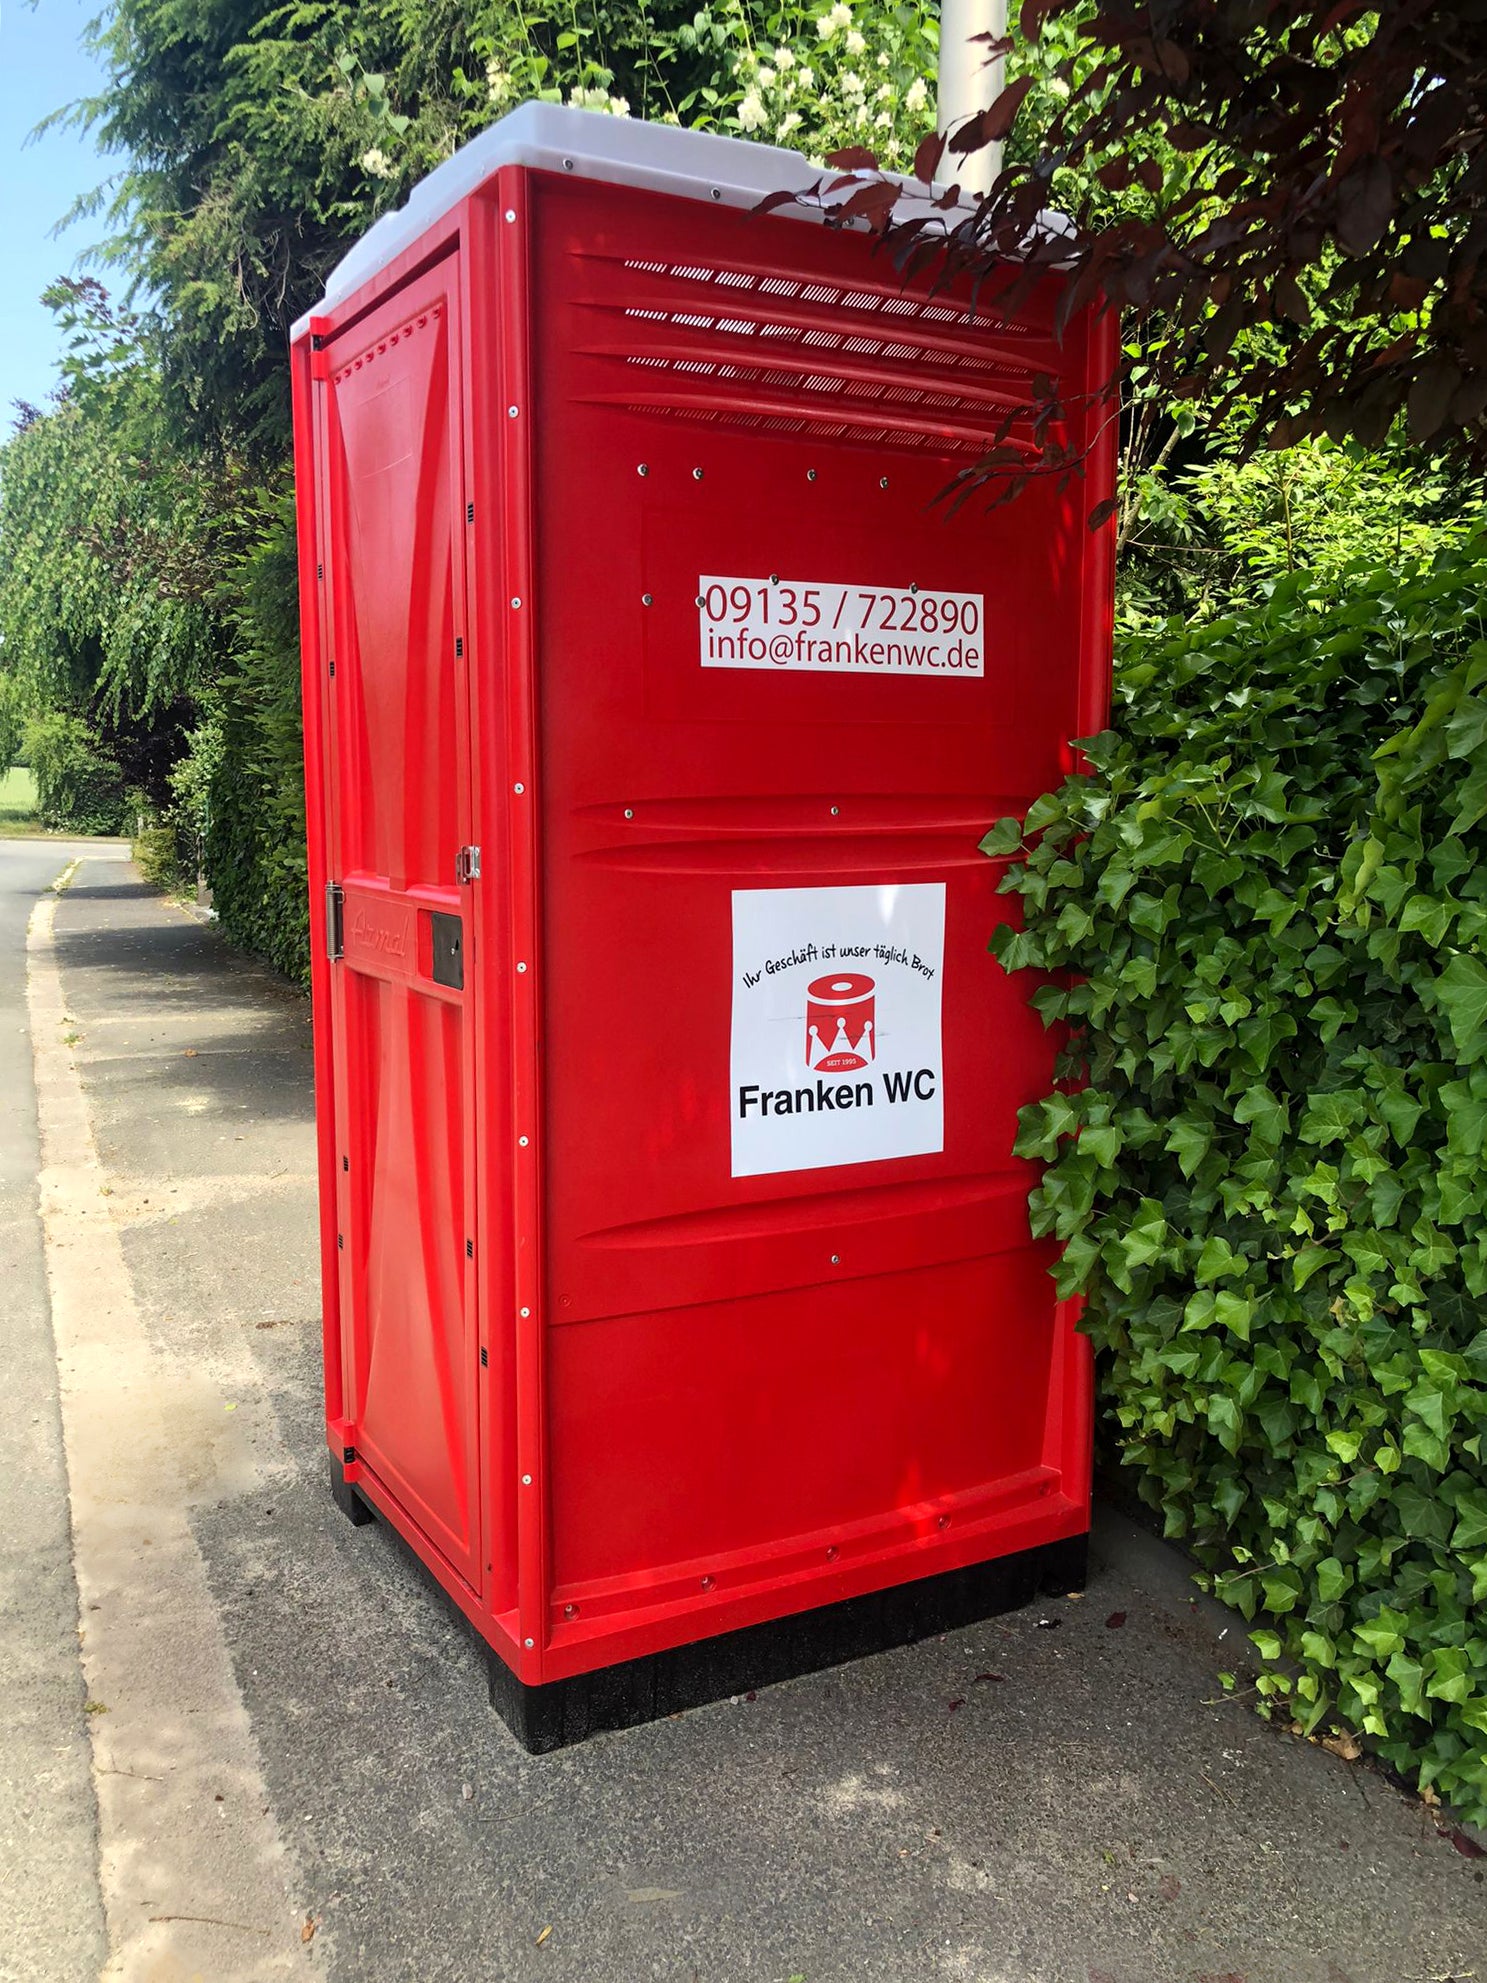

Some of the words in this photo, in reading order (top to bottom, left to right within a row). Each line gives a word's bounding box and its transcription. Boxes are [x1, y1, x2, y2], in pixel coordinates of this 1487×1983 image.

[705, 584, 821, 626] 09135
[832, 591, 848, 629] /
[858, 594, 979, 635] 722890
[708, 628, 979, 669] info@frankenwc.de
[742, 970, 763, 989] Ihr
[765, 943, 818, 975] Geschäft
[821, 944, 836, 959] ist
[839, 946, 871, 958] unser
[873, 944, 909, 966] täglich
[911, 954, 935, 981] Brot
[739, 1080, 874, 1118] Franken
[883, 1069, 935, 1103] WC
